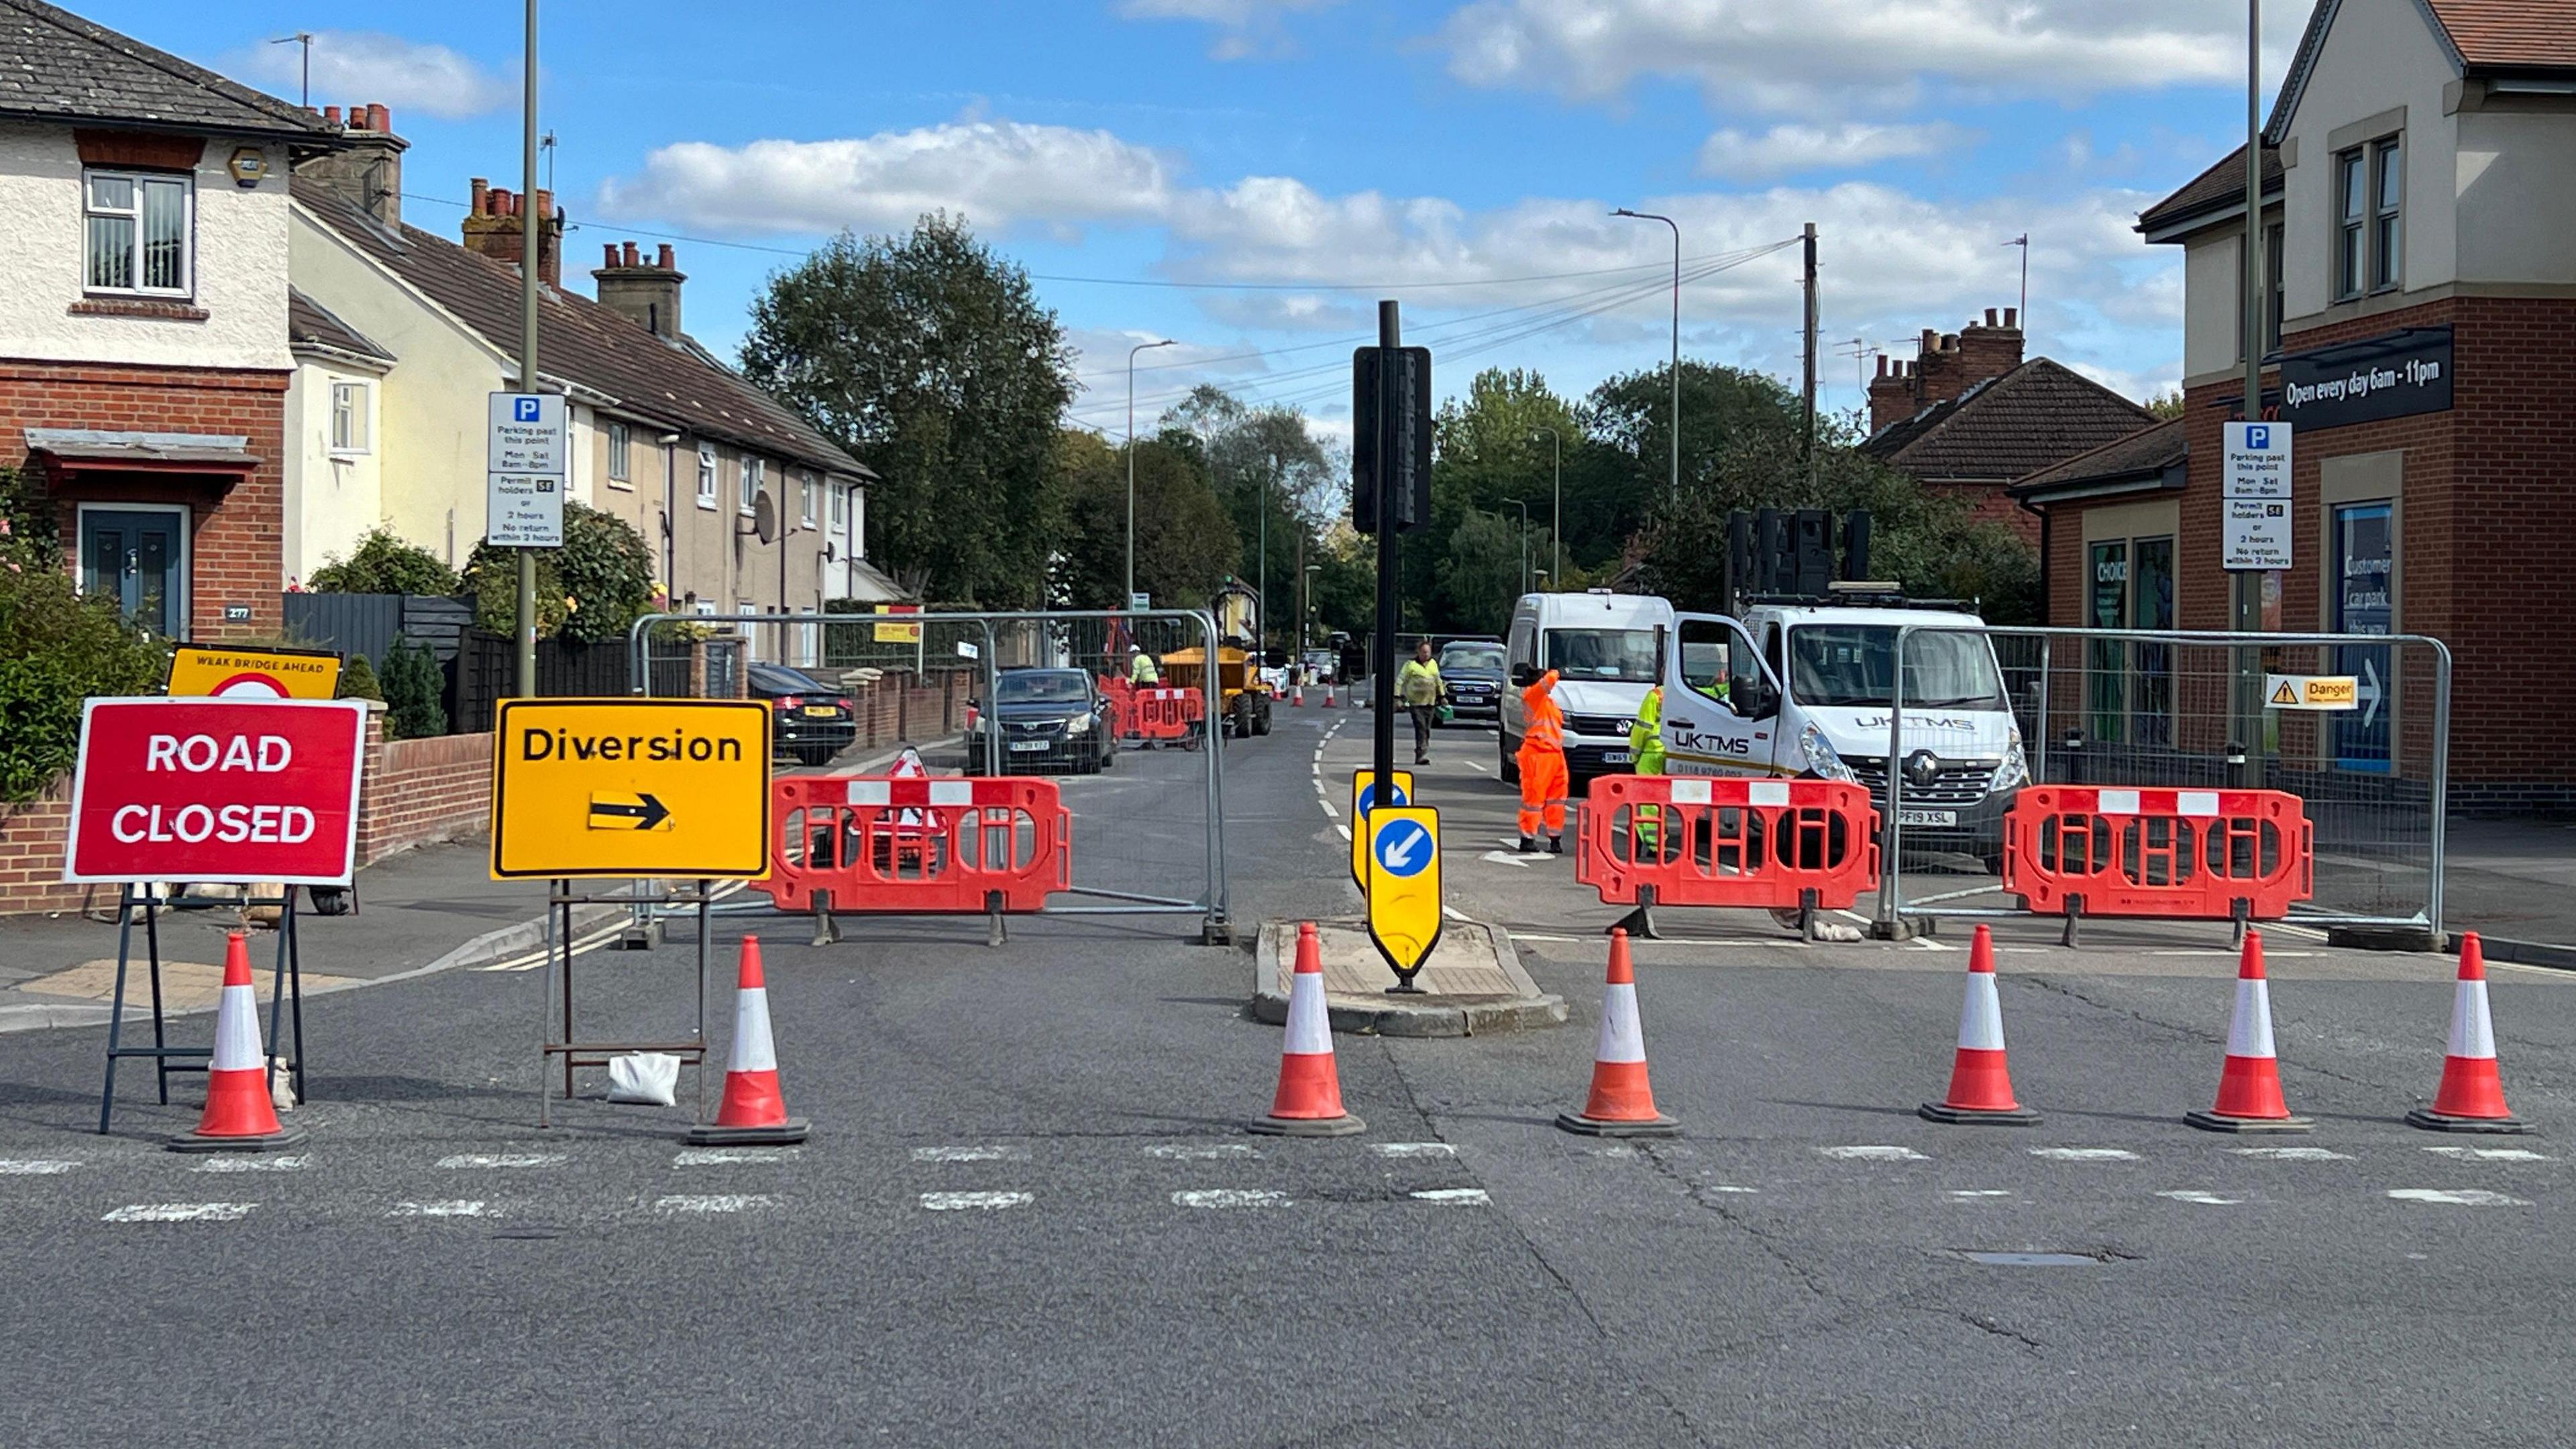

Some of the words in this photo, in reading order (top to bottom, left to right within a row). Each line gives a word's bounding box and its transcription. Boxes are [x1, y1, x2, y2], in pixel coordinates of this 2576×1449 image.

[2287, 382, 2315, 409] Open
[2316, 379, 2348, 401] every
[2349, 371, 2369, 397] day
[2370, 367, 2395, 390] 6am
[2406, 359, 2440, 387] 11pm
[521, 400, 537, 419] P
[498, 426, 533, 435] Parking
[2251, 429, 2266, 447] P
[504, 450, 525, 458] Mon
[2231, 453, 2263, 462] Parking
[2255, 463, 2278, 471] point
[498, 486, 533, 494] holders
[2234, 502, 2263, 510] Permit
[517, 512, 544, 520] hours
[502, 523, 517, 531] No
[533, 534, 559, 542] hours
[2241, 535, 2247, 543] 2
[2249, 535, 2274, 543] hours
[2236, 547, 2249, 555] No
[2255, 557, 2261, 565] 2
[2264, 557, 2289, 566] hours
[2346, 555, 2392, 577] Customer
[2349, 592, 2365, 606] car
[2365, 586, 2388, 610] park
[229, 608, 248, 619] 277
[197, 655, 230, 667] WEAK
[235, 658, 278, 671] BRIDGE
[282, 662, 324, 674] AHEAD
[2309, 683, 2351, 697] Danger
[523, 728, 741, 761] Diversion
[146, 734, 292, 772] ROAD
[1927, 812, 1949, 823] XSL
[111, 804, 315, 843] CLOSED
